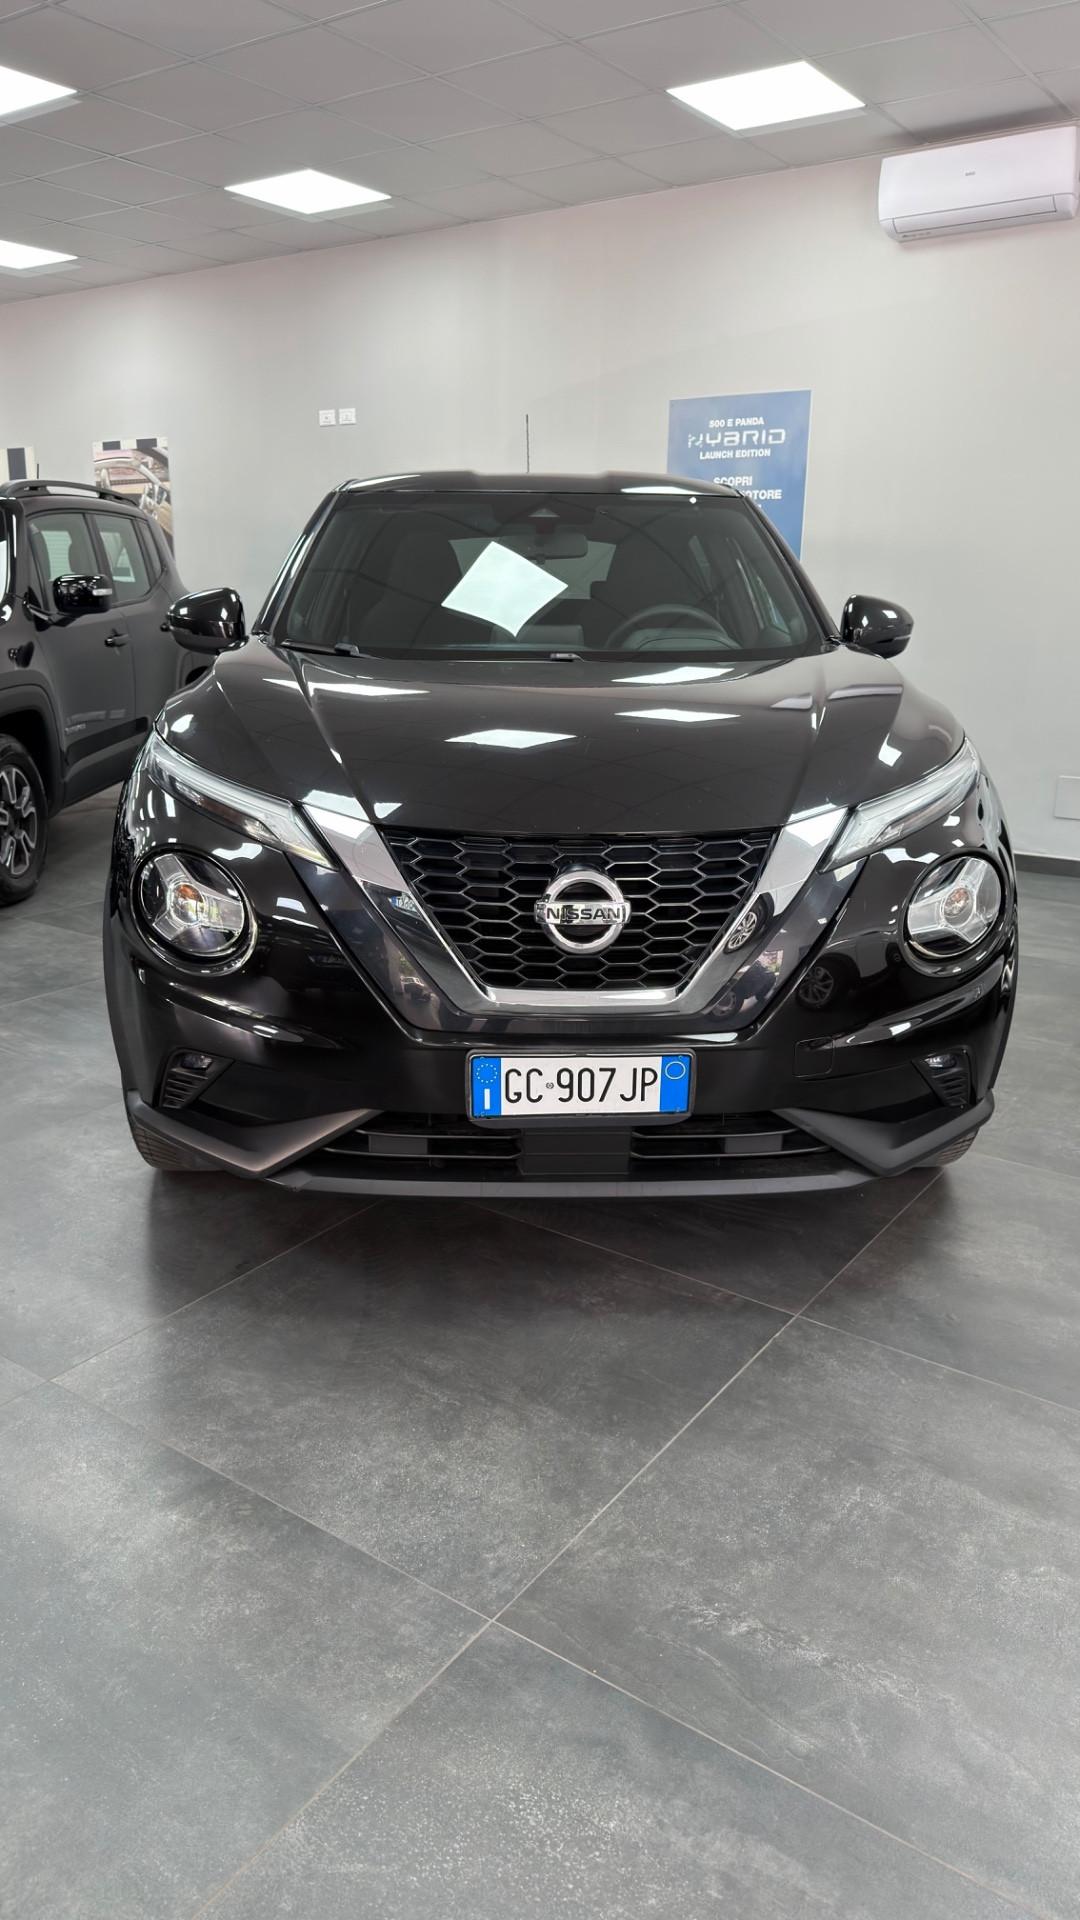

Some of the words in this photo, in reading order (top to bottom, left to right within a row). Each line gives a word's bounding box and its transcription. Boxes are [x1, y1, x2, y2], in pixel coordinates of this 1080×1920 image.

[709, 420, 725, 428] 500
[727, 419, 734, 427] E
[735, 417, 764, 426] PANDA
[688, 429, 785, 448] HYBRID
[700, 450, 733, 460] LAUNCH
[735, 448, 771, 458] EDITION
[713, 476, 752, 487] SCOPRI
[740, 489, 782, 500] OTORE
[546, 907, 620, 920] NISSAN
[505, 1068, 543, 1104] GC
